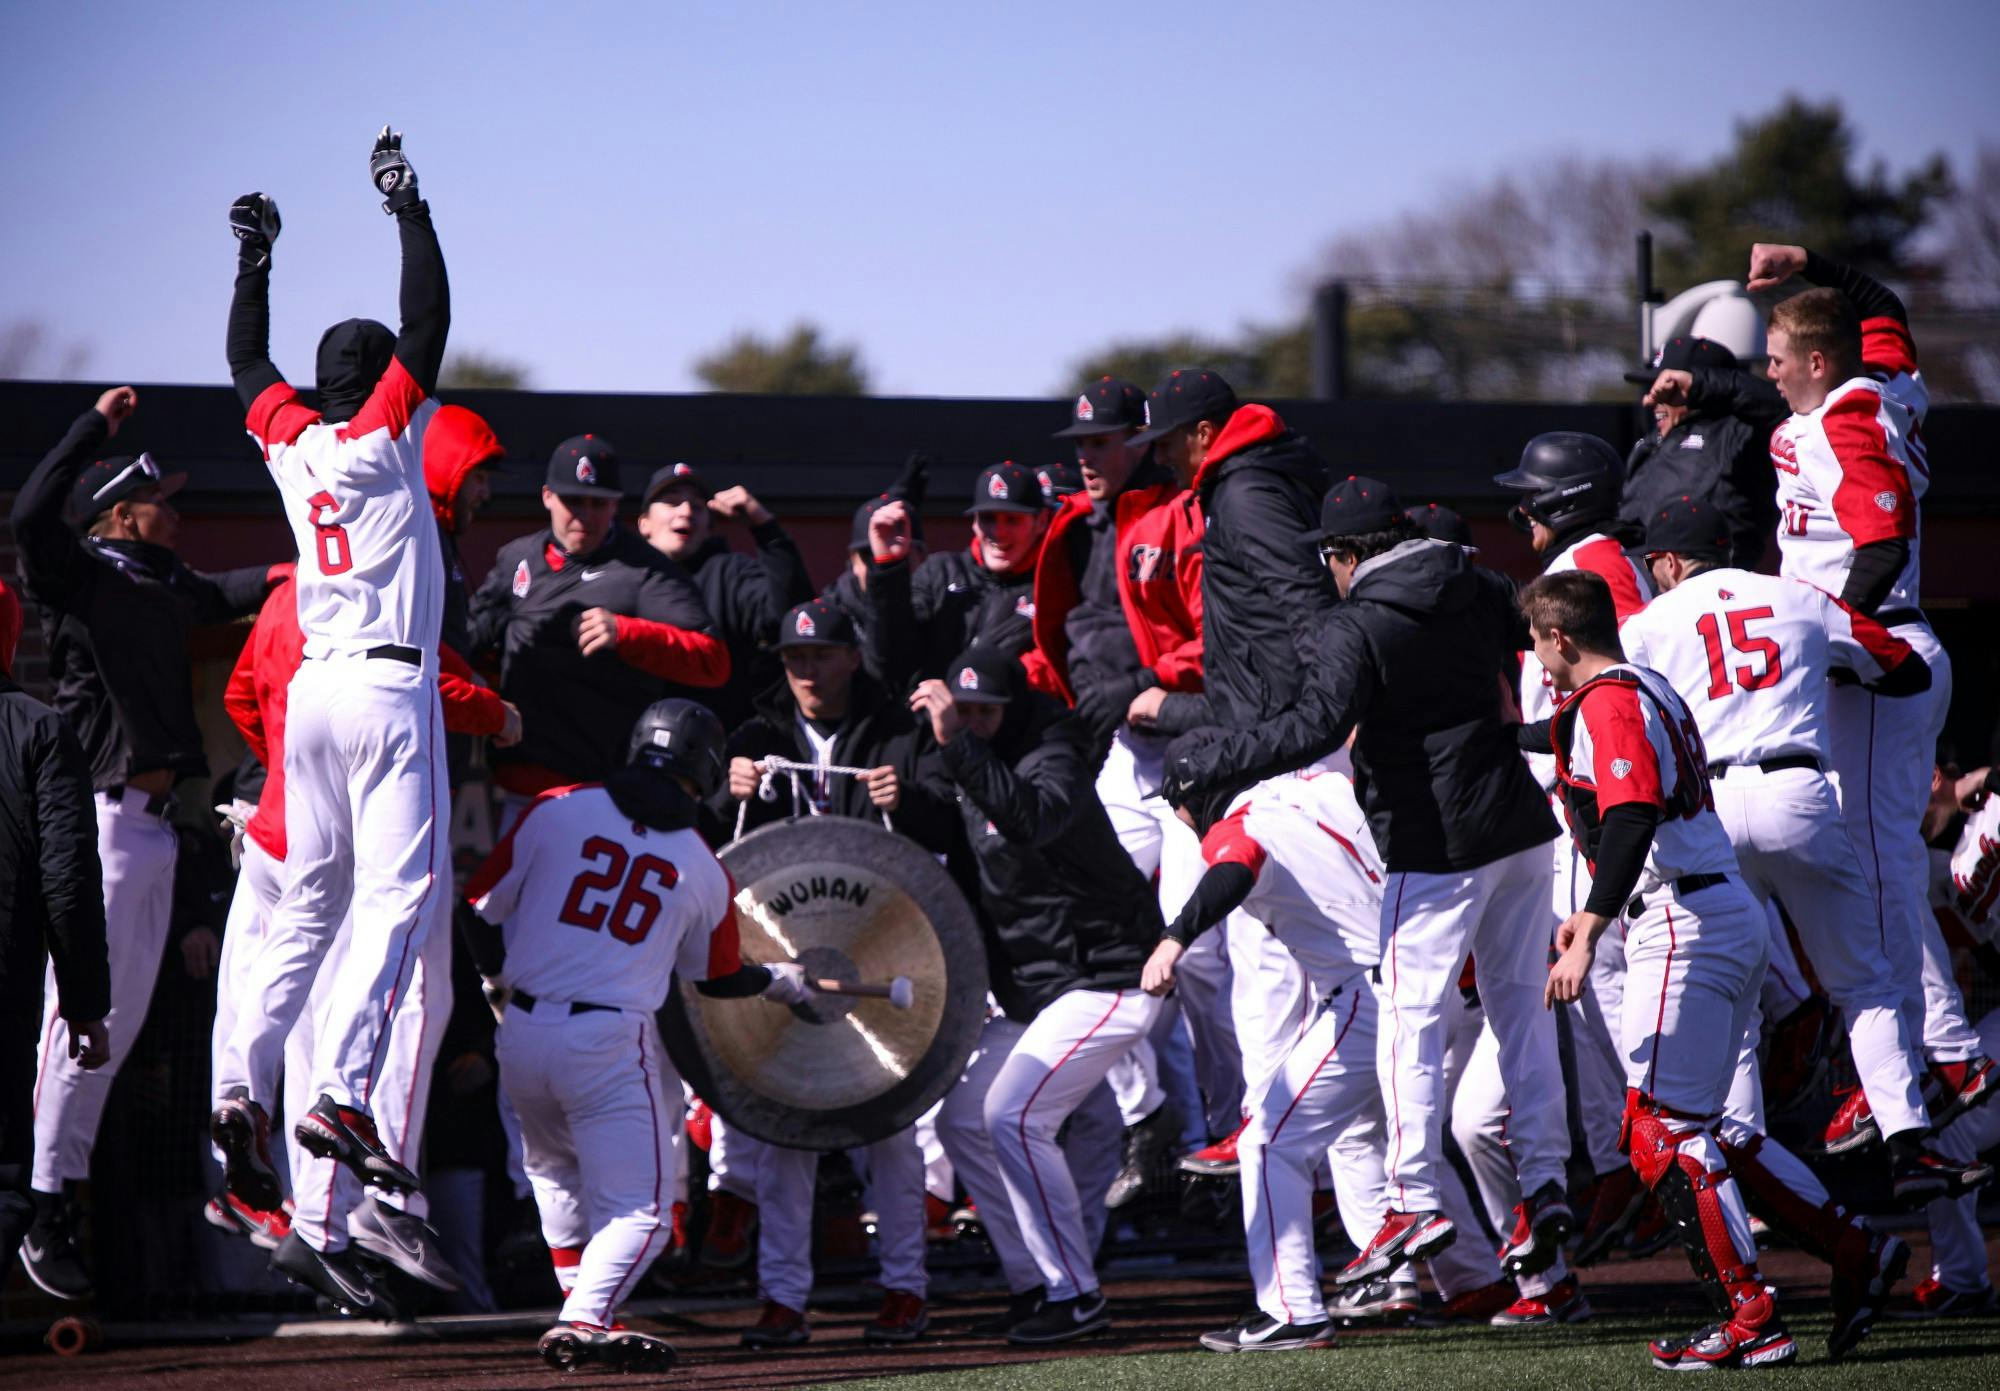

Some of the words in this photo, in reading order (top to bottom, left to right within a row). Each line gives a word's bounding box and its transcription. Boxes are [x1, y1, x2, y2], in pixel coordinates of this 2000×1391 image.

[306, 489, 353, 576] 6
[1695, 605, 1783, 701] 15
[557, 834, 679, 946] 26
[768, 876, 870, 916] WUHAN
